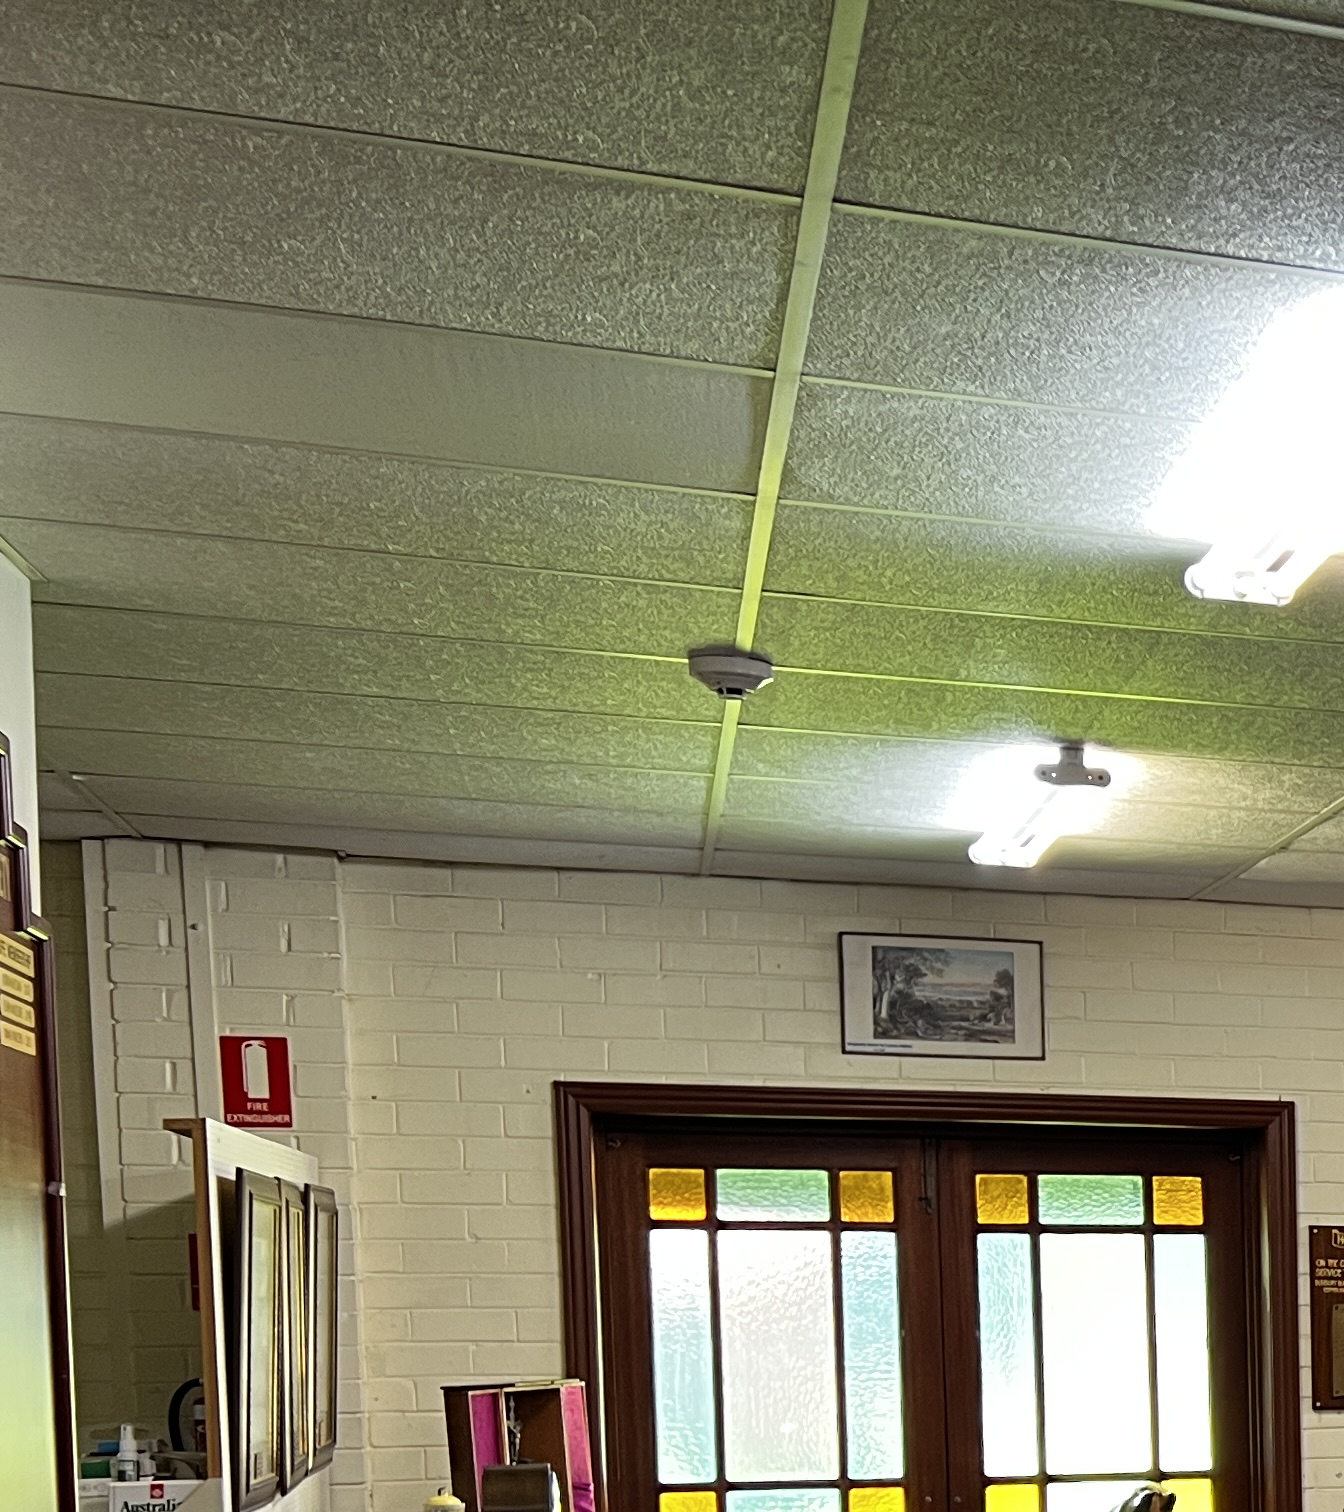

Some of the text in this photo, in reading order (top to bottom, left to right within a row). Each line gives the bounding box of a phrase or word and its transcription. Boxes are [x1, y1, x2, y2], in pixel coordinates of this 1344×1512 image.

[246, 1102, 269, 1111] FIRE
[226, 1113, 290, 1123] EXTINGUISHER
[1315, 1259, 1326, 1267] ON
[1327, 1259, 1338, 1268] THE
[1315, 1268, 1342, 1277] SERVICE
